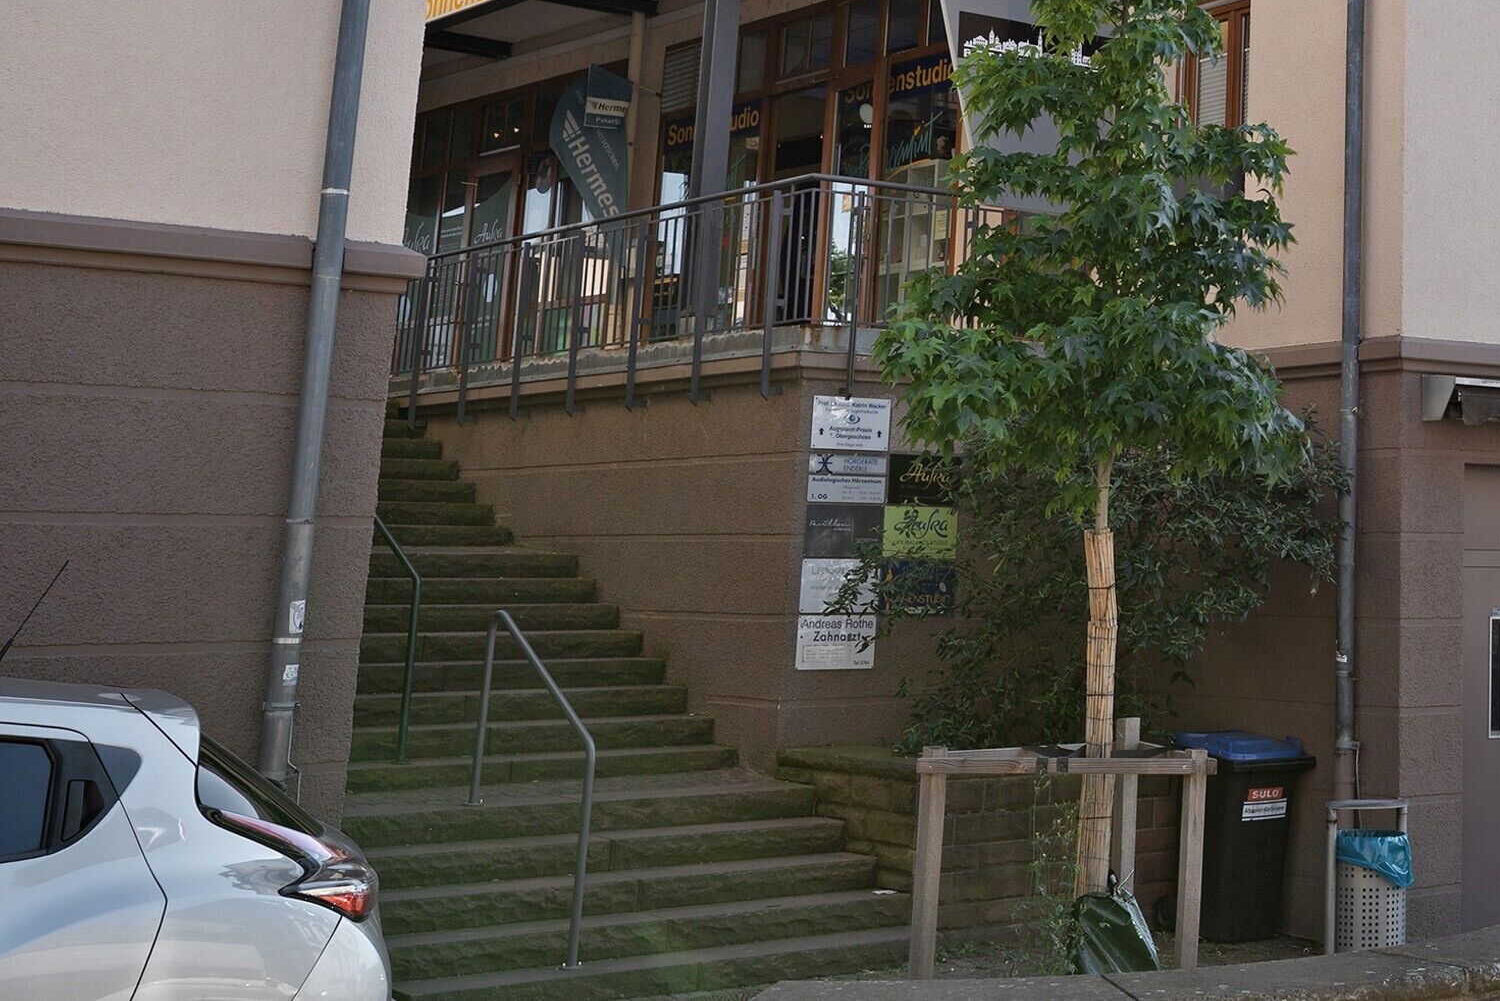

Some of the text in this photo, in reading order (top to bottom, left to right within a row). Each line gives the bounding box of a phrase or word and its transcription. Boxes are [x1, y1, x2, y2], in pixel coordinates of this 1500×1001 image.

[568, 135, 620, 220] Hermes
[801, 618, 873, 629] Andreas Rothe
[1252, 789, 1279, 798] SULO
